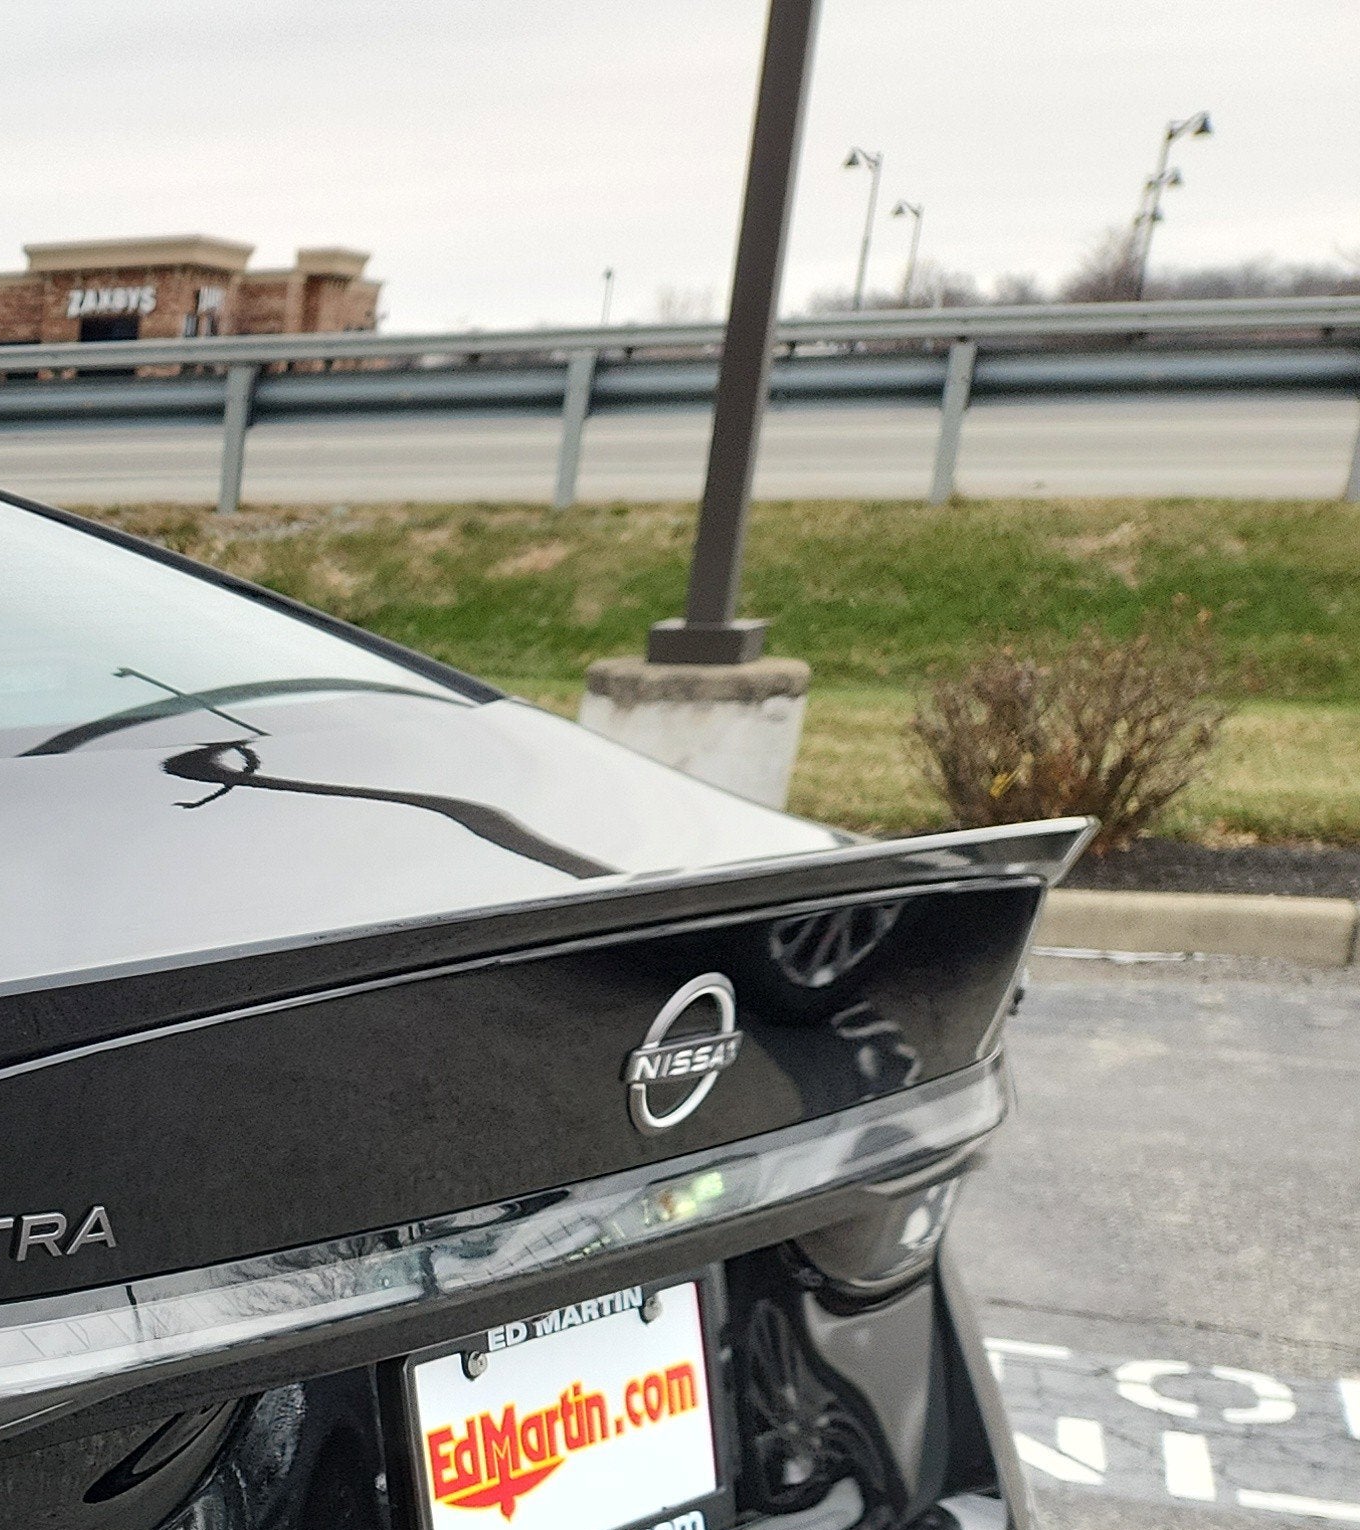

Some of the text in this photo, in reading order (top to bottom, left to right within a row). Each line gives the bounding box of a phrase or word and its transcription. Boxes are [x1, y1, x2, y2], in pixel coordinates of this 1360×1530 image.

[488, 1285, 644, 1352] ED MARTIN
[426, 1360, 700, 1504] EdMartin.com
